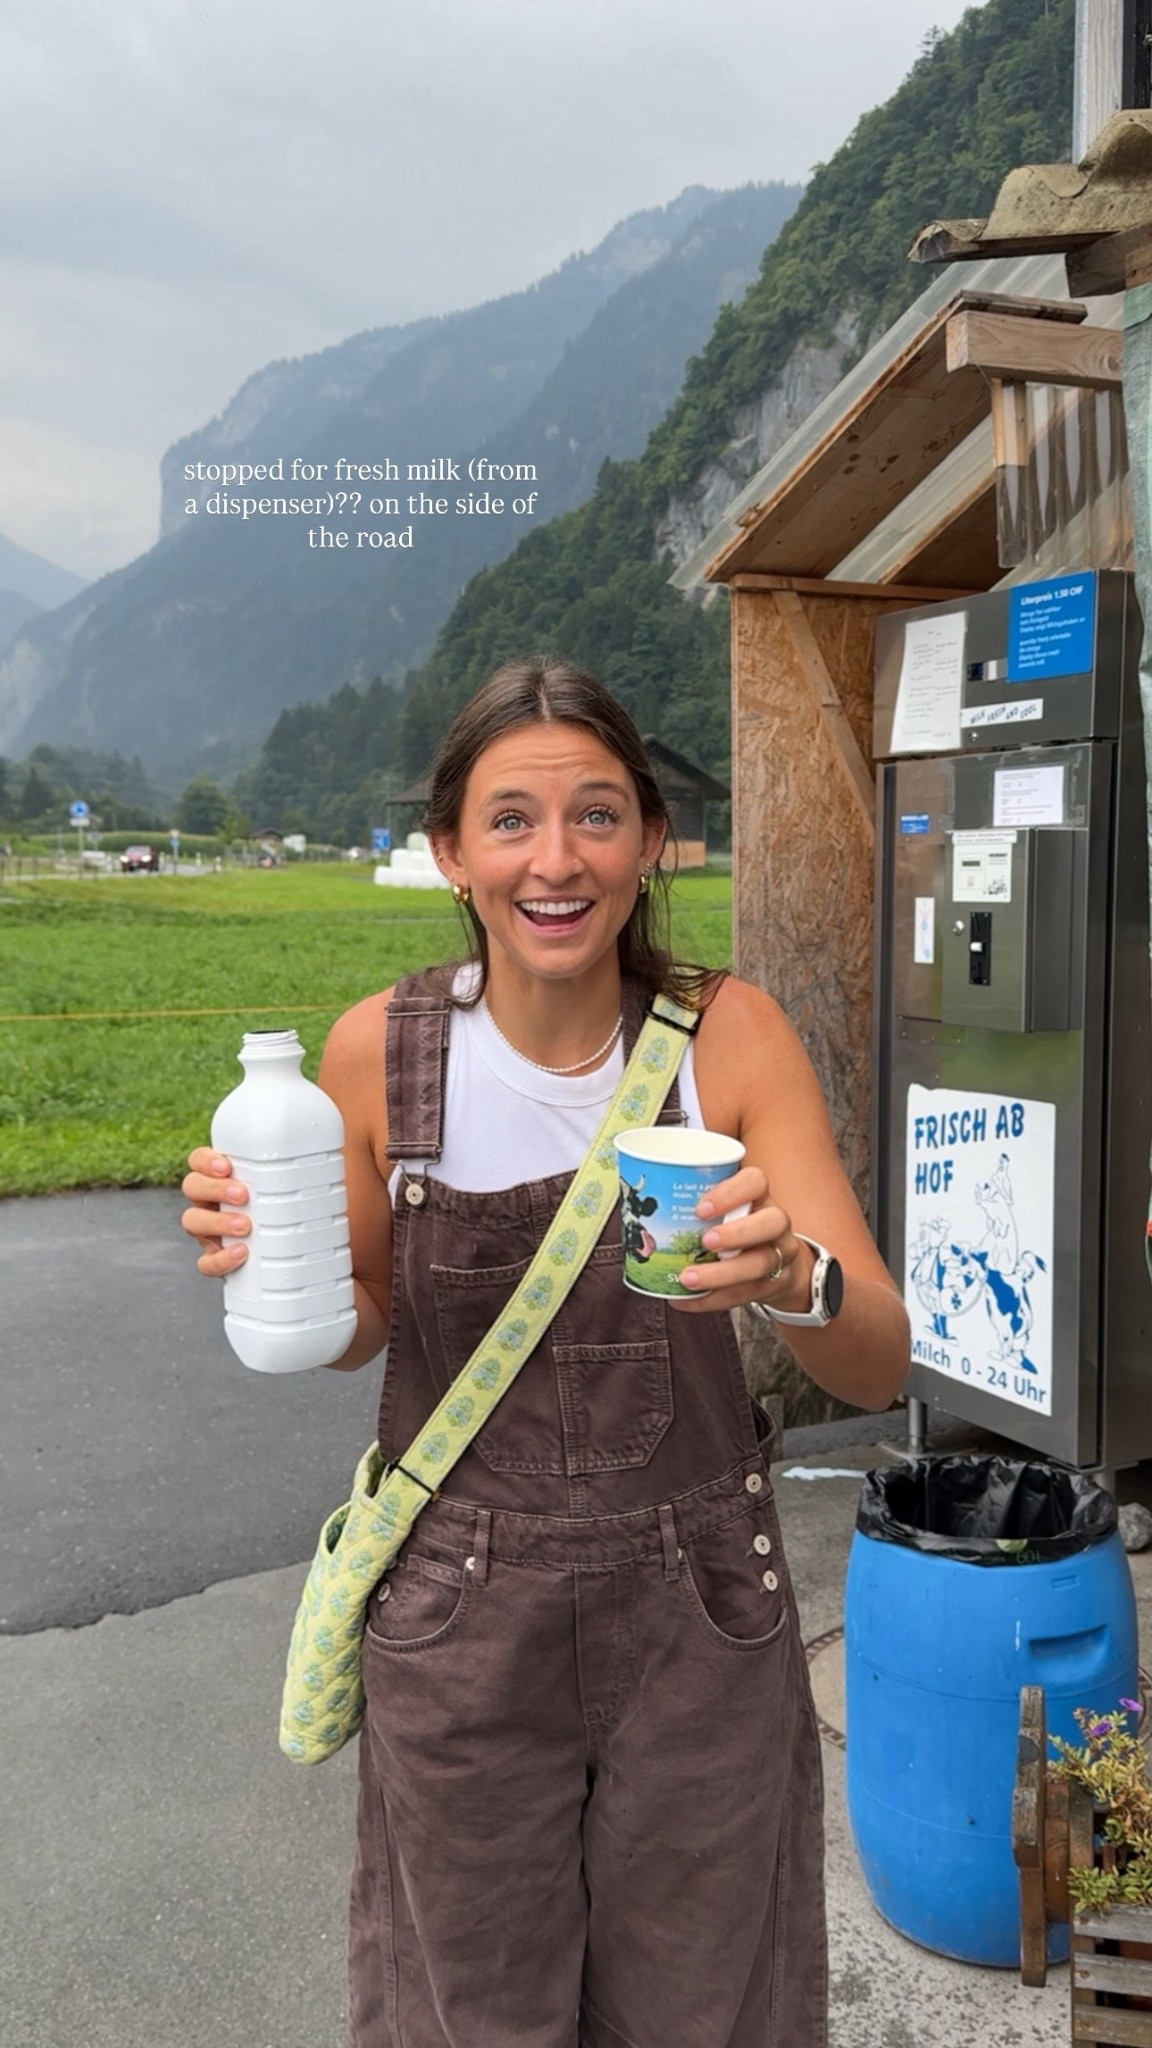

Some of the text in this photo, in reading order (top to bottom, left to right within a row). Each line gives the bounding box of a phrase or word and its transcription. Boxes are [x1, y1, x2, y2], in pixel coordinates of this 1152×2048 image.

[1005, 706, 1019, 721] AND
[1020, 703, 1037, 719] COOL
[915, 1102, 1025, 1149] FRISCH AB
[915, 1160, 954, 1195] HOF
[960, 1356, 971, 1376] 0
[987, 1366, 1008, 1389] 24
[1014, 1374, 1047, 1404] Uhr
